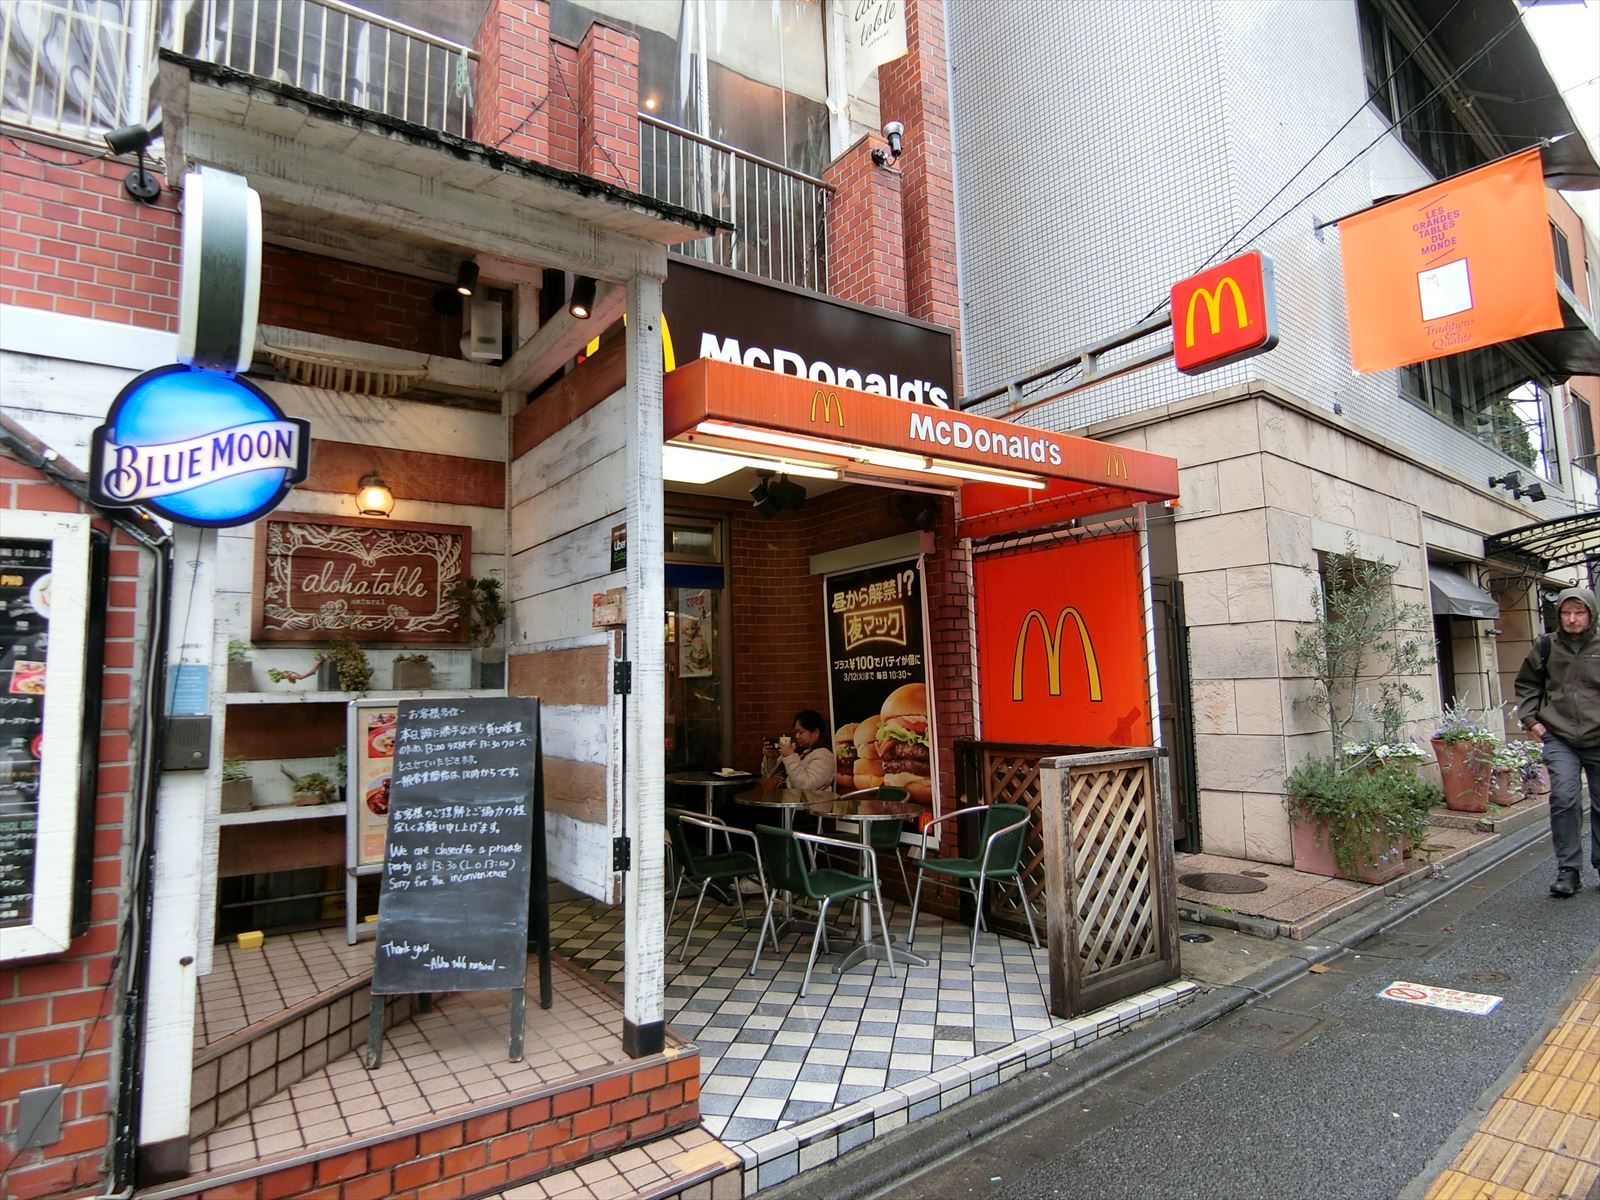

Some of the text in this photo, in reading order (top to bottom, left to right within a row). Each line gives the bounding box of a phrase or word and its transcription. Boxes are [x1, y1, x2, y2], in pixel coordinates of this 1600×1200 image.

[1413, 210, 1461, 232] GRANDES
[1426, 207, 1444, 219] LES
[1418, 220, 1456, 238] TABLES
[1421, 236, 1457, 255] MONDE
[1431, 233, 1445, 244] DU
[1424, 317, 1475, 336] Traditions
[909, 413, 1062, 466] McDonald's
[104, 430, 293, 499] BLUE MOON
[614, 540, 627, 551] Uber
[848, 612, 900, 643] 夜マック
[390, 843, 408, 858] We
[414, 847, 430, 856] are
[479, 847, 487, 855] a
[489, 843, 523, 857] private
[388, 862, 413, 876] party
[416, 861, 429, 871] at
[389, 870, 508, 891] Sorry for the inconvenience
[382, 941, 413, 957] Thank
